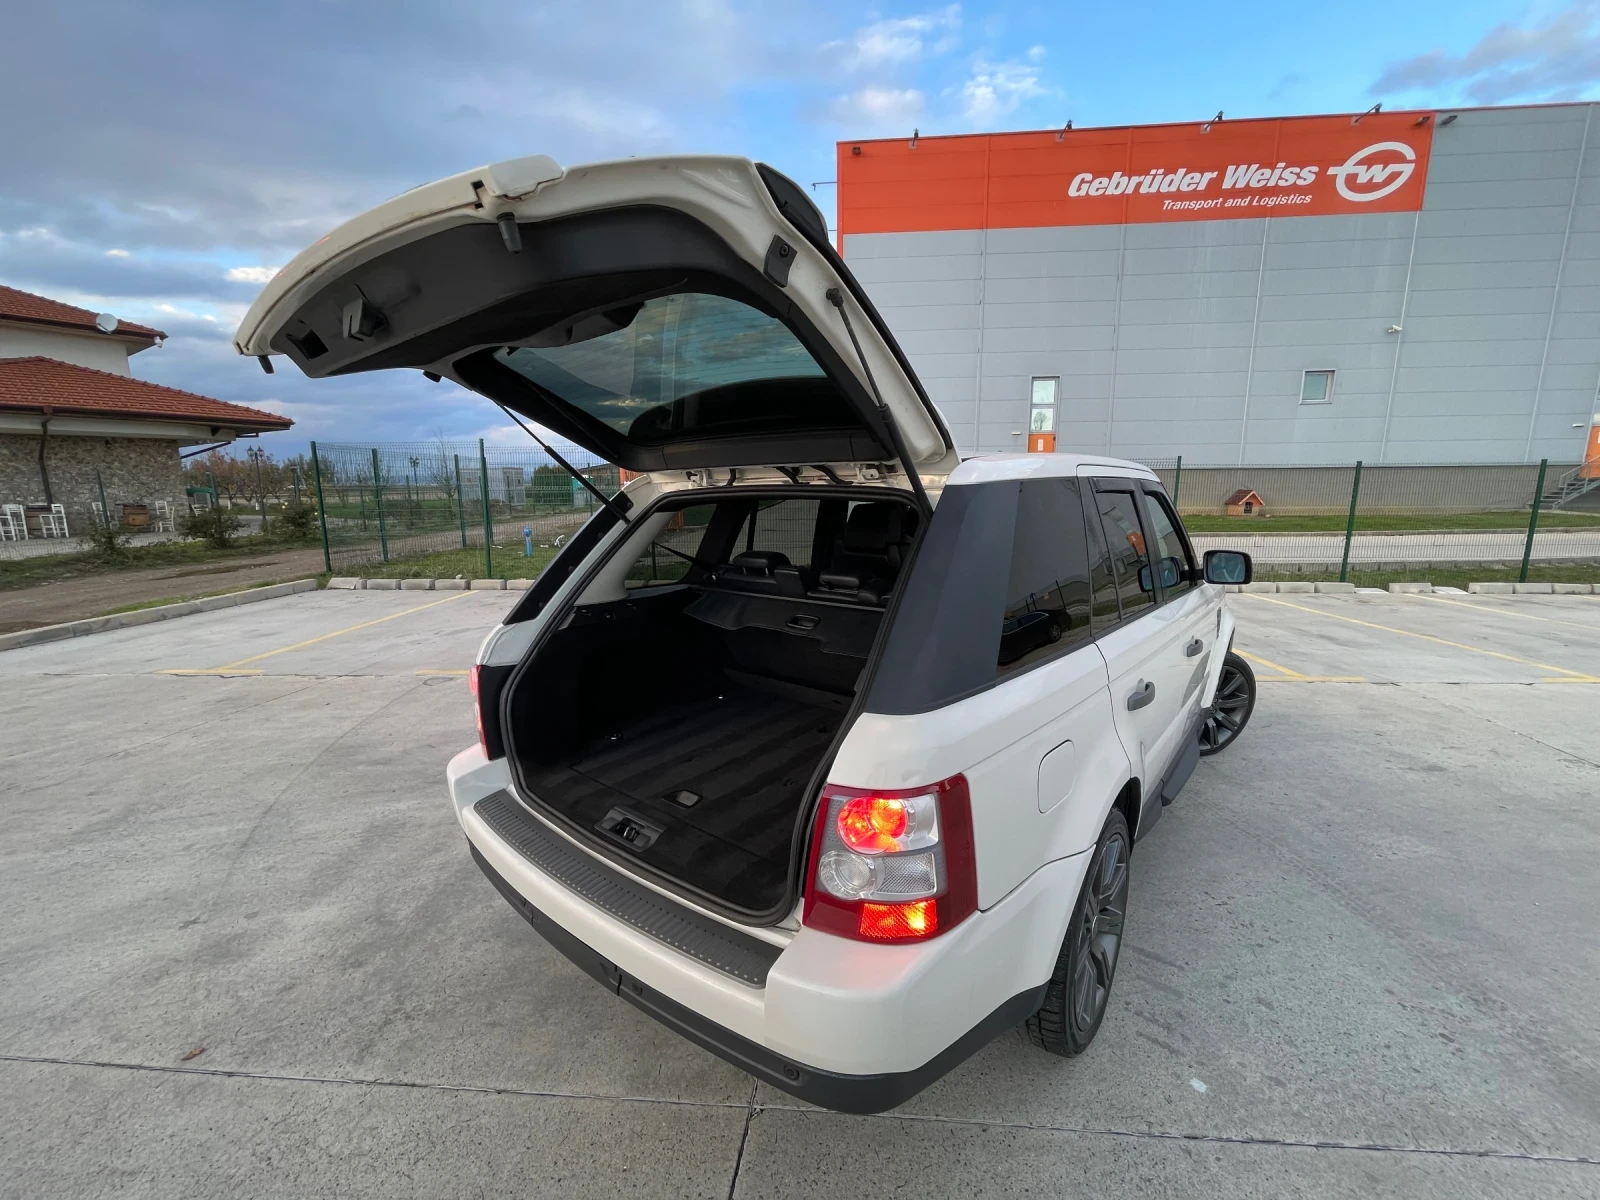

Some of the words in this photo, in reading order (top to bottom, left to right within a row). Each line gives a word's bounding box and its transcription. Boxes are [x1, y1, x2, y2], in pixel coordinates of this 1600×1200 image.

[1067, 168, 1217, 197] Gebrüder
[1222, 162, 1319, 190] Weiss
[1162, 198, 1222, 211] Transport
[1224, 196, 1250, 207] and
[1252, 193, 1312, 207] Logistics
